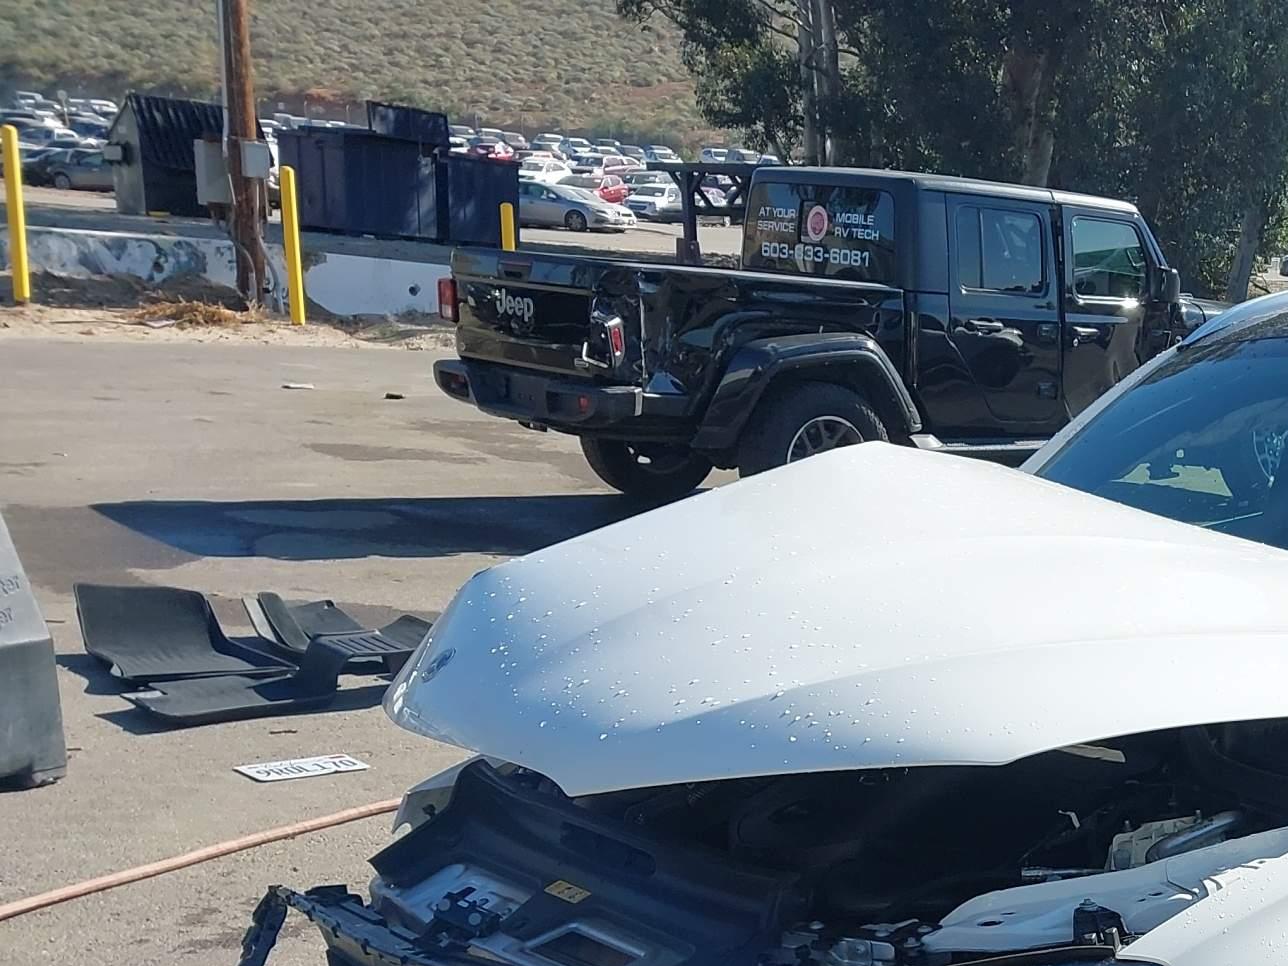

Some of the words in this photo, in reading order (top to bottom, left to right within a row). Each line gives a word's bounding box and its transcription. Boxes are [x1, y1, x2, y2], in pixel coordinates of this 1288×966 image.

[758, 207, 772, 217] AT
[772, 207, 796, 218] YOUR
[835, 212, 875, 226] MOBILE
[757, 220, 795, 233] SERVICE
[834, 227, 849, 238] RV
[851, 228, 880, 241] TECH
[495, 288, 534, 322] Jeep
